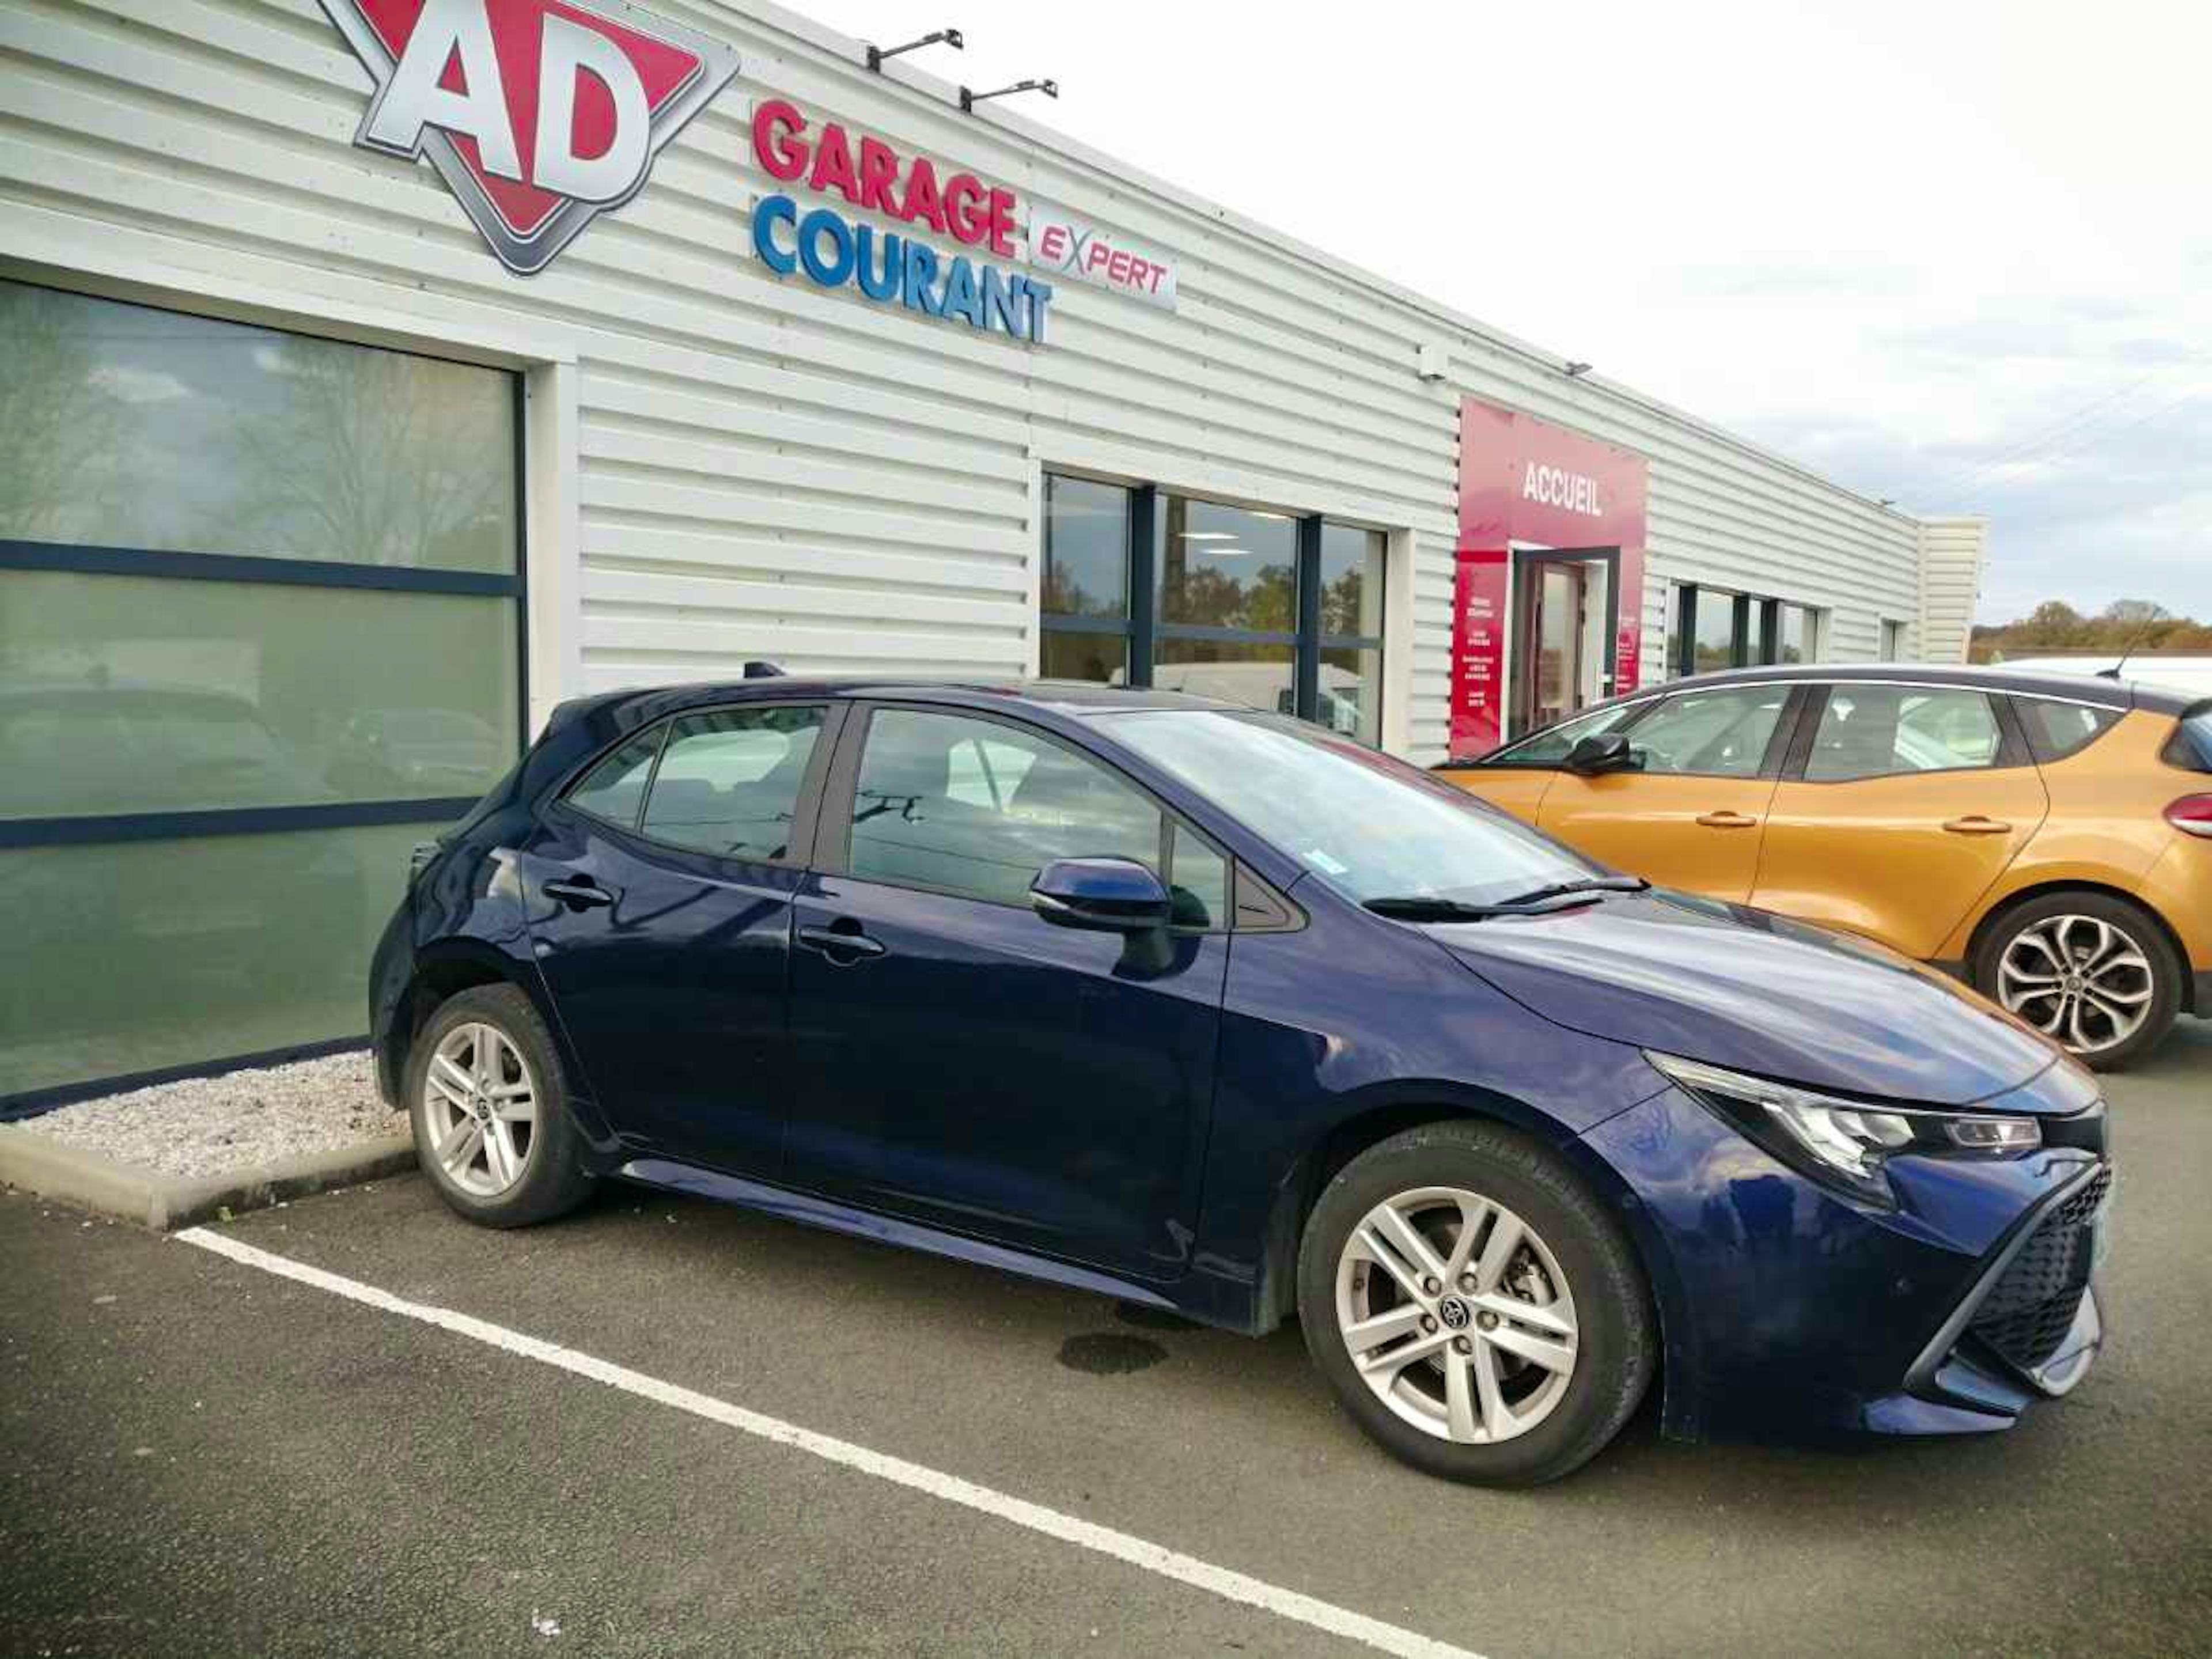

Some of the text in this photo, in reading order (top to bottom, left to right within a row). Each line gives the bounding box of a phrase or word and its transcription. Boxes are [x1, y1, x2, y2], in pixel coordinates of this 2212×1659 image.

[367, 0, 650, 203] AD
[752, 99, 1017, 259] GARAGE
[752, 194, 1053, 345] COURANT
[1523, 460, 1603, 517] ACCUEIL
